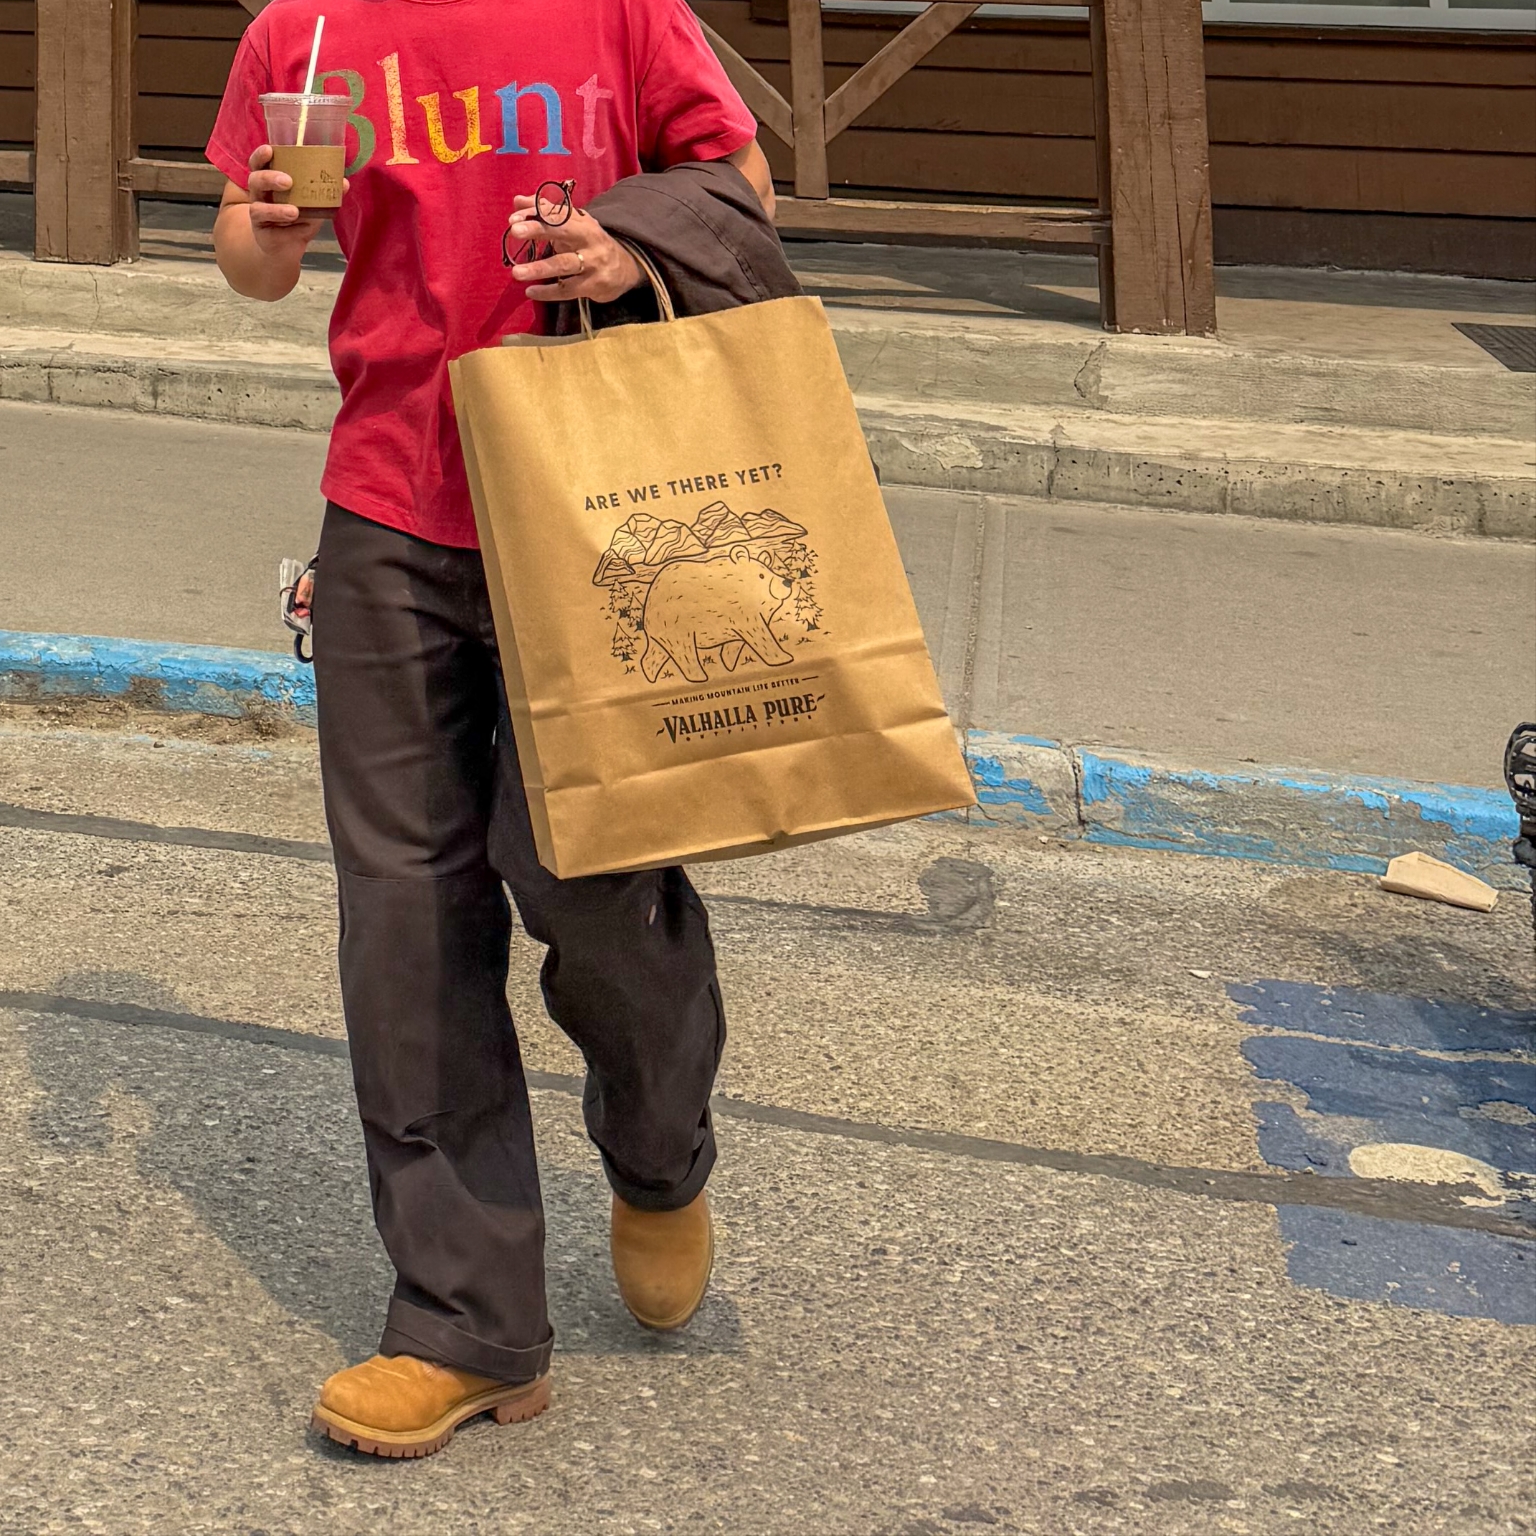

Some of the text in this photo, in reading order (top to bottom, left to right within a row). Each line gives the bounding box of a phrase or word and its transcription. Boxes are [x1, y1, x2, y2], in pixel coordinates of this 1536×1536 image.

[585, 463, 783, 511] ARE WE THERE YET?
[671, 694, 705, 706] MAKING
[707, 687, 750, 700] MOUNTAIN
[772, 678, 800, 689] BETTER
[663, 693, 818, 744] VALHALLA PURE
